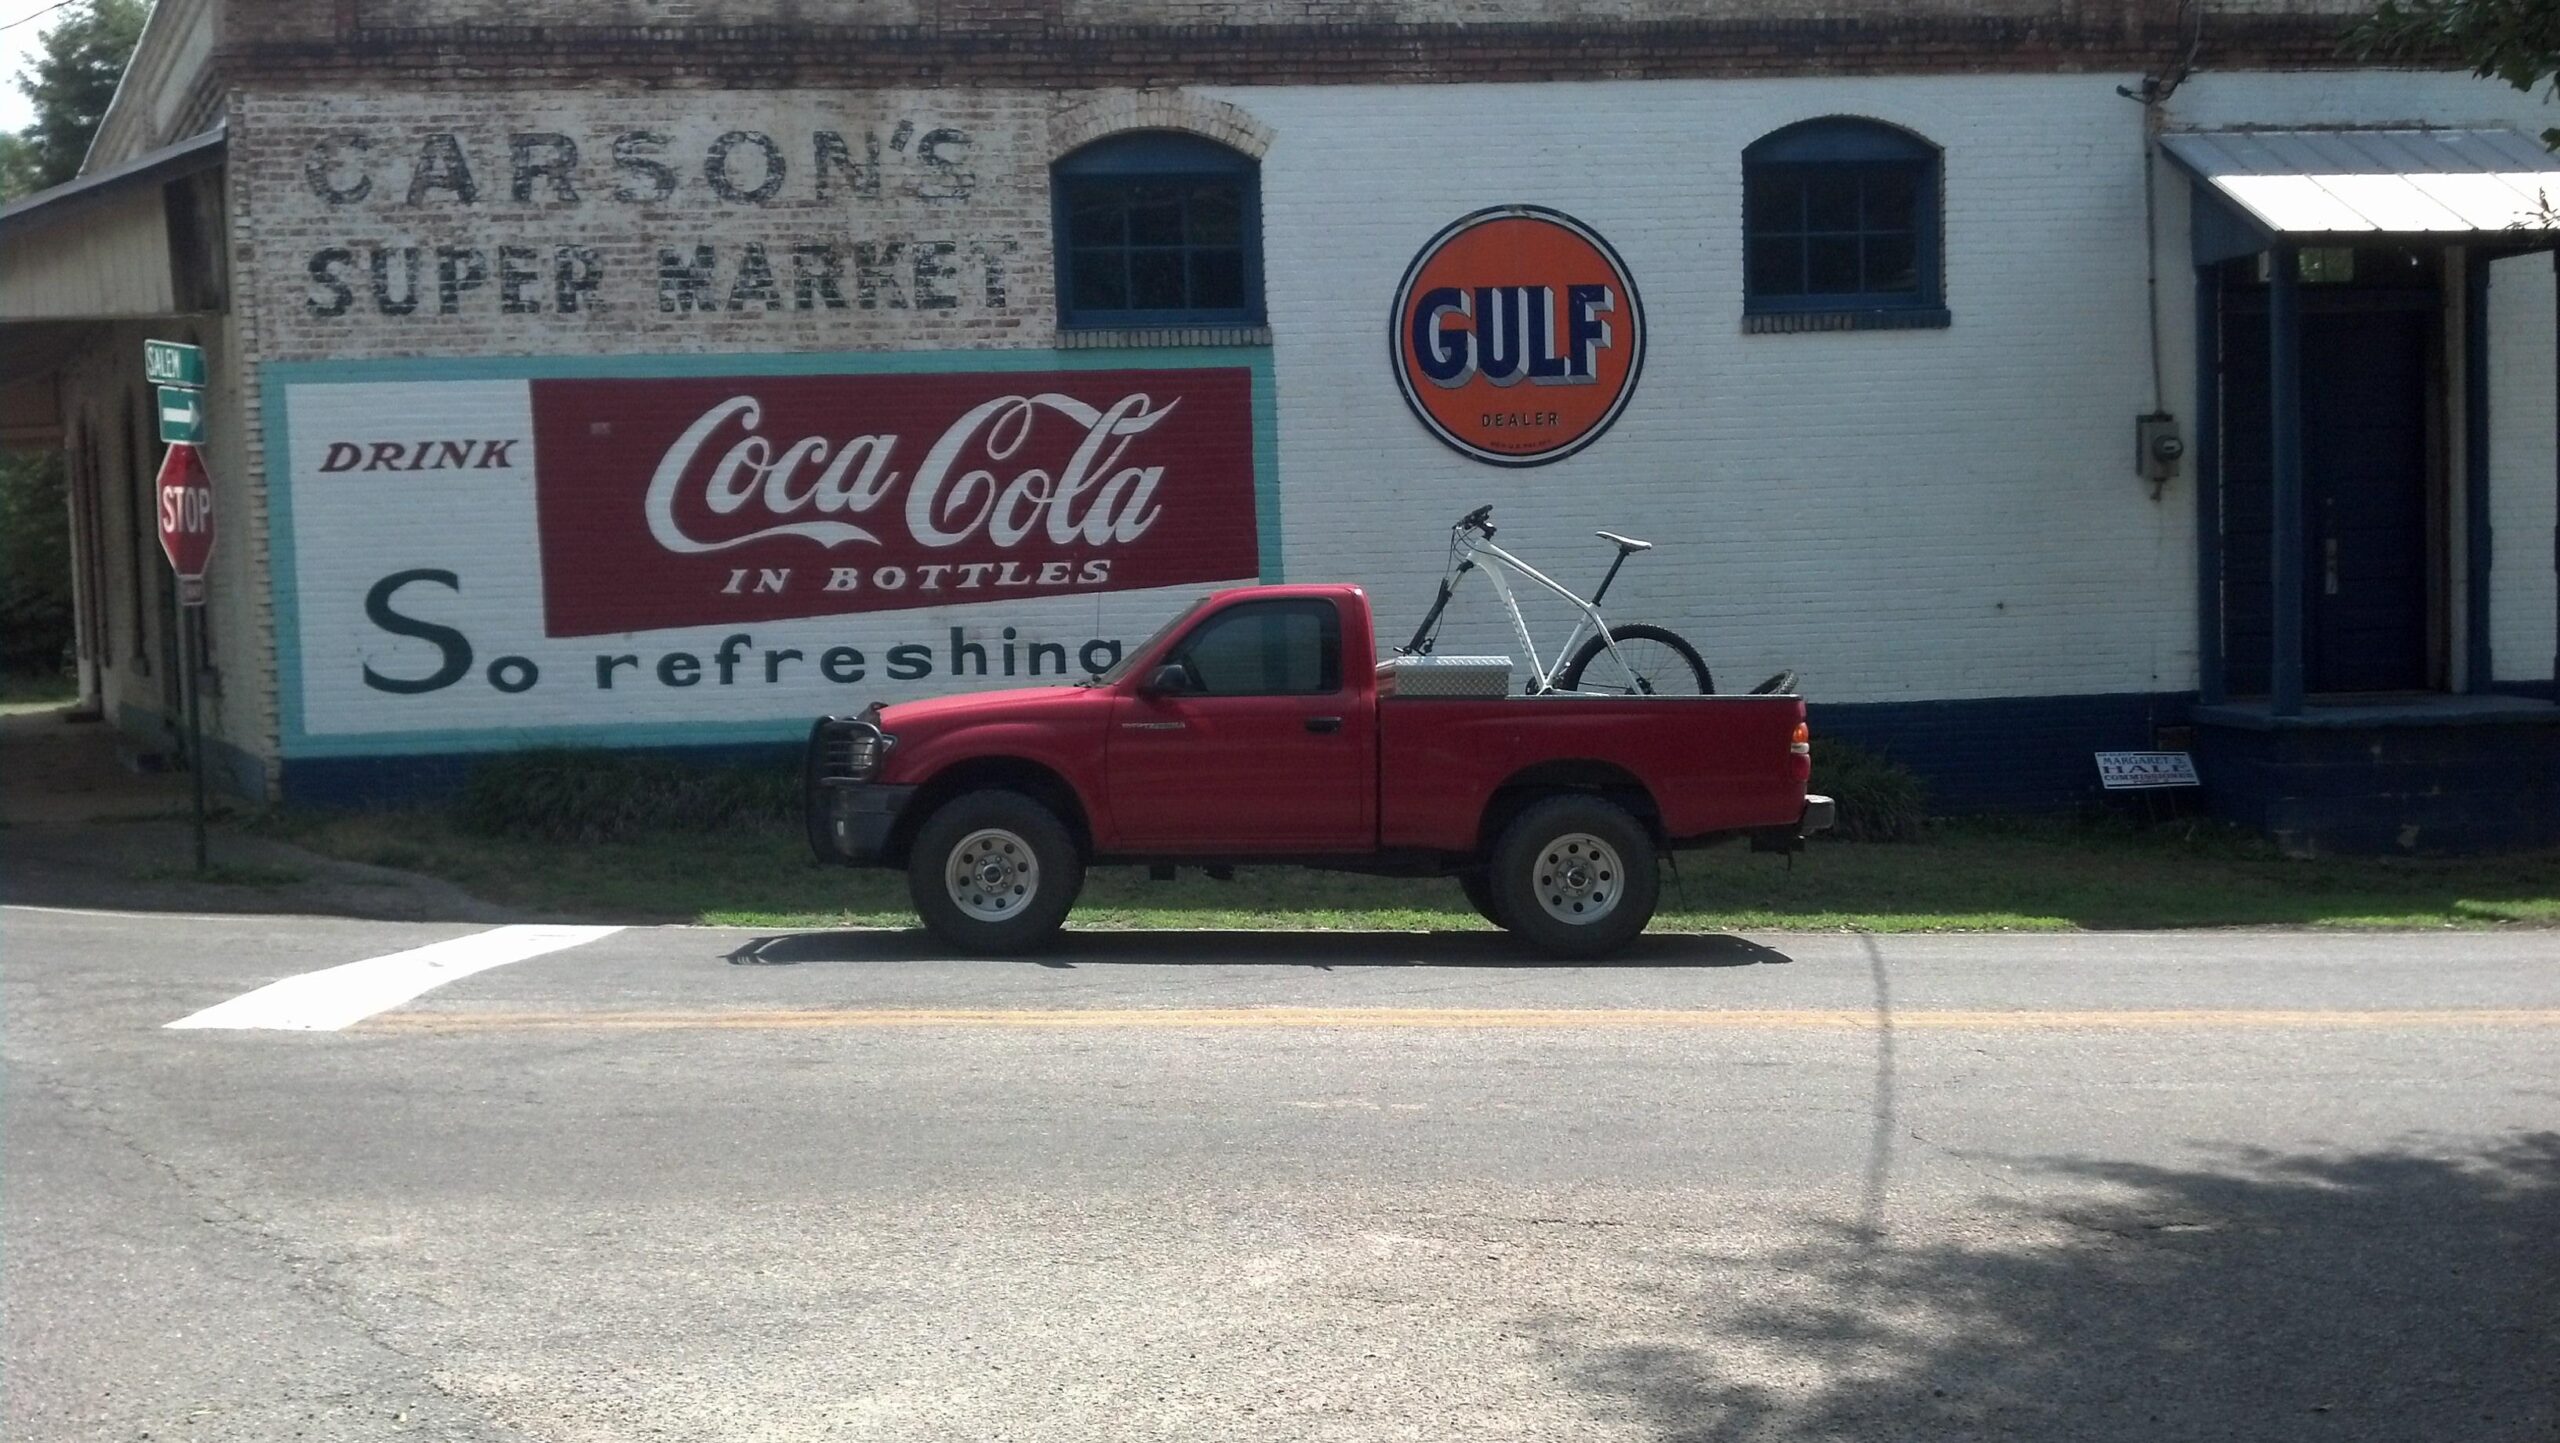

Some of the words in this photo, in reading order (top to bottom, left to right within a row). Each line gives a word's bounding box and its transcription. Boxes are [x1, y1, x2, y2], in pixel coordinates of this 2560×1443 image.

[304, 119, 976, 204] CARSON'S
[306, 244, 603, 317] SUPER
[658, 240, 1018, 313] MARKET
[1412, 284, 1616, 390] GULF
[146, 345, 182, 378] SALEM
[1481, 411, 1560, 428] DEALER
[318, 438, 519, 473] DRINK
[644, 394, 900, 554] Coca
[904, 392, 1183, 548] Cola
[162, 485, 211, 533] STOP
[721, 567, 792, 594] IN
[822, 559, 1113, 592] BOTTLES
[362, 567, 540, 695] So
[595, 625, 1122, 690] refreshing
[2102, 764, 2192, 774] HALE
[2103, 756, 2169, 765] MARGARET
